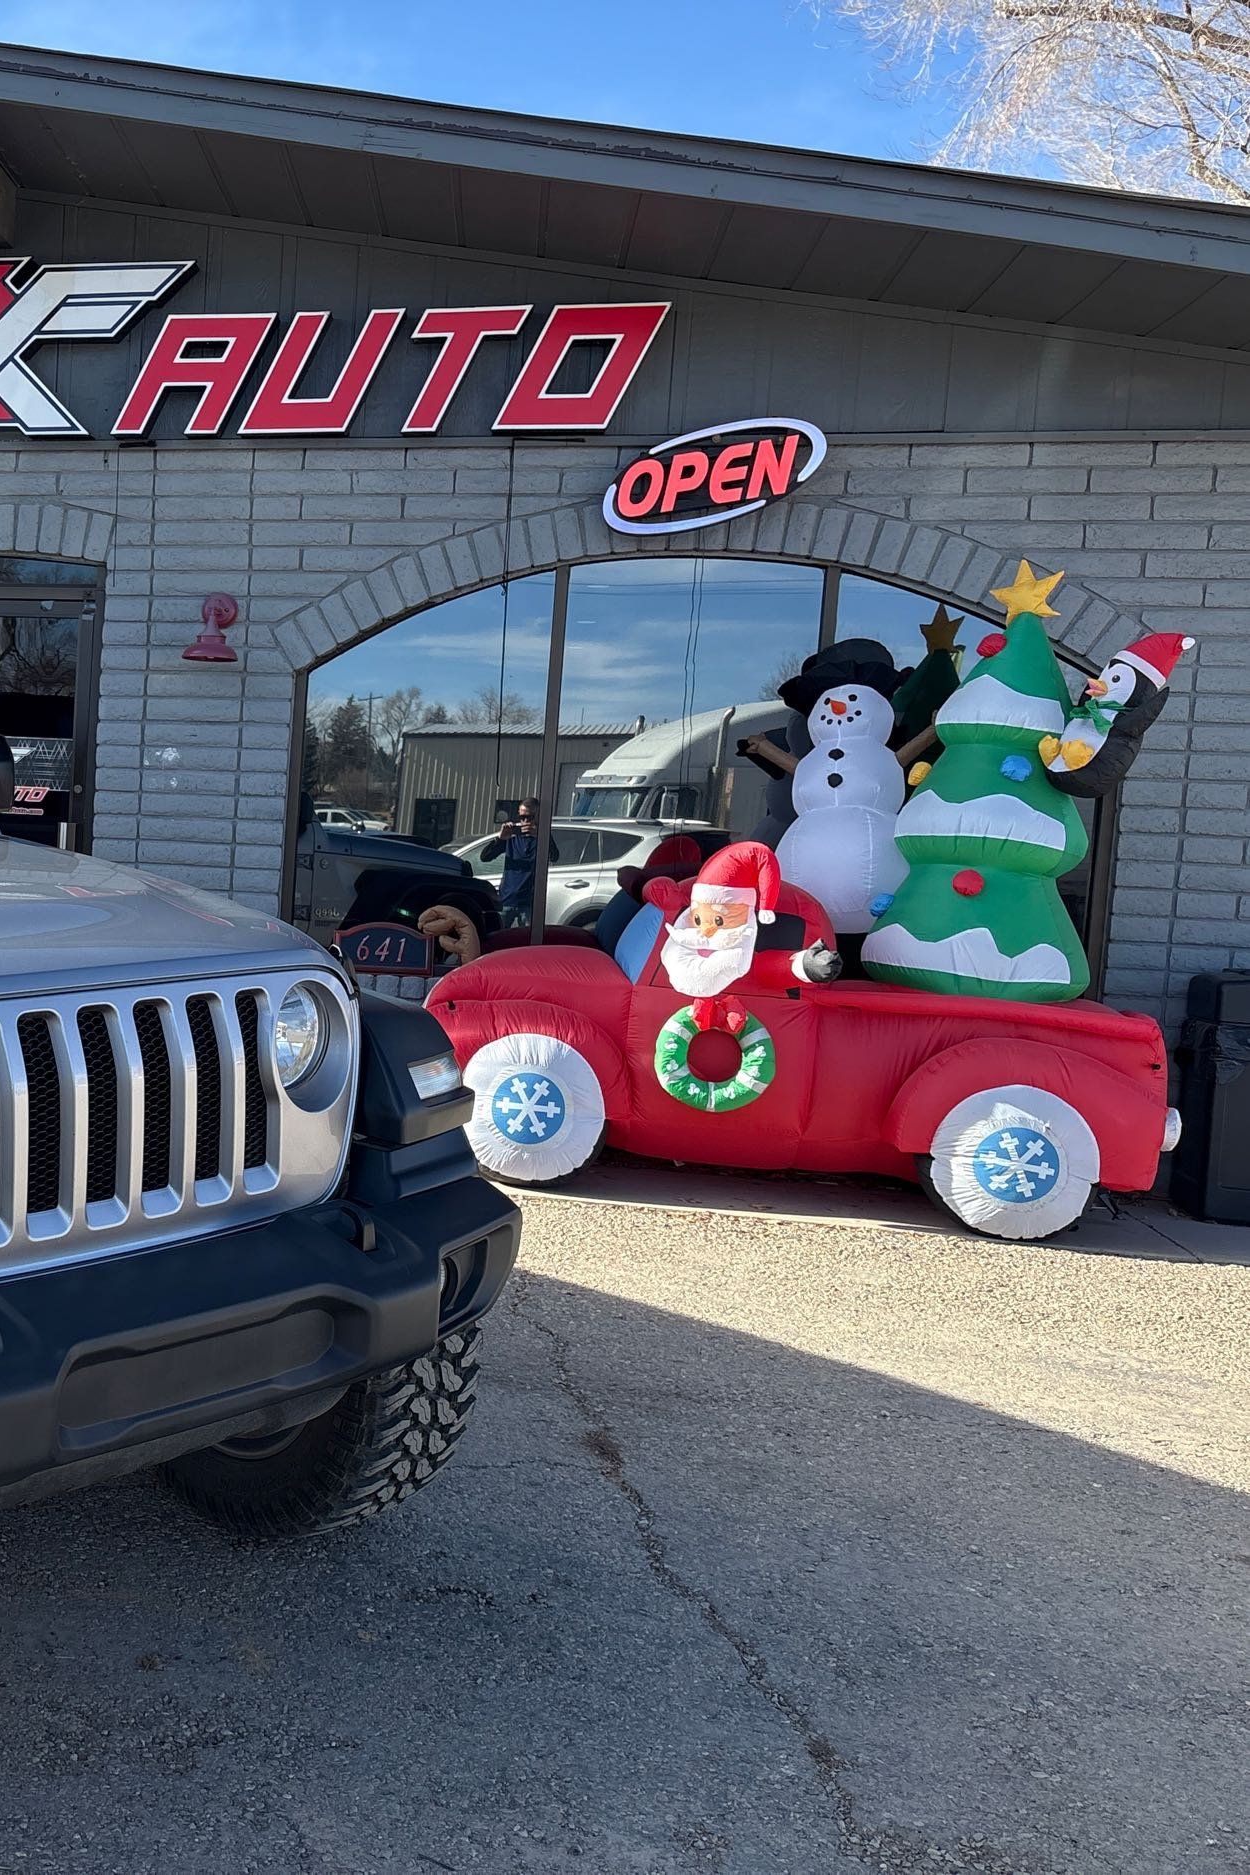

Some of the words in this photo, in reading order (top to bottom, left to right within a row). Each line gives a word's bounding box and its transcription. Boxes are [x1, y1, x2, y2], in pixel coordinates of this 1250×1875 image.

[110, 302, 672, 434] AUTO
[617, 434, 800, 518] OPEN
[14, 785, 49, 802] TO
[357, 935, 406, 962] 641
